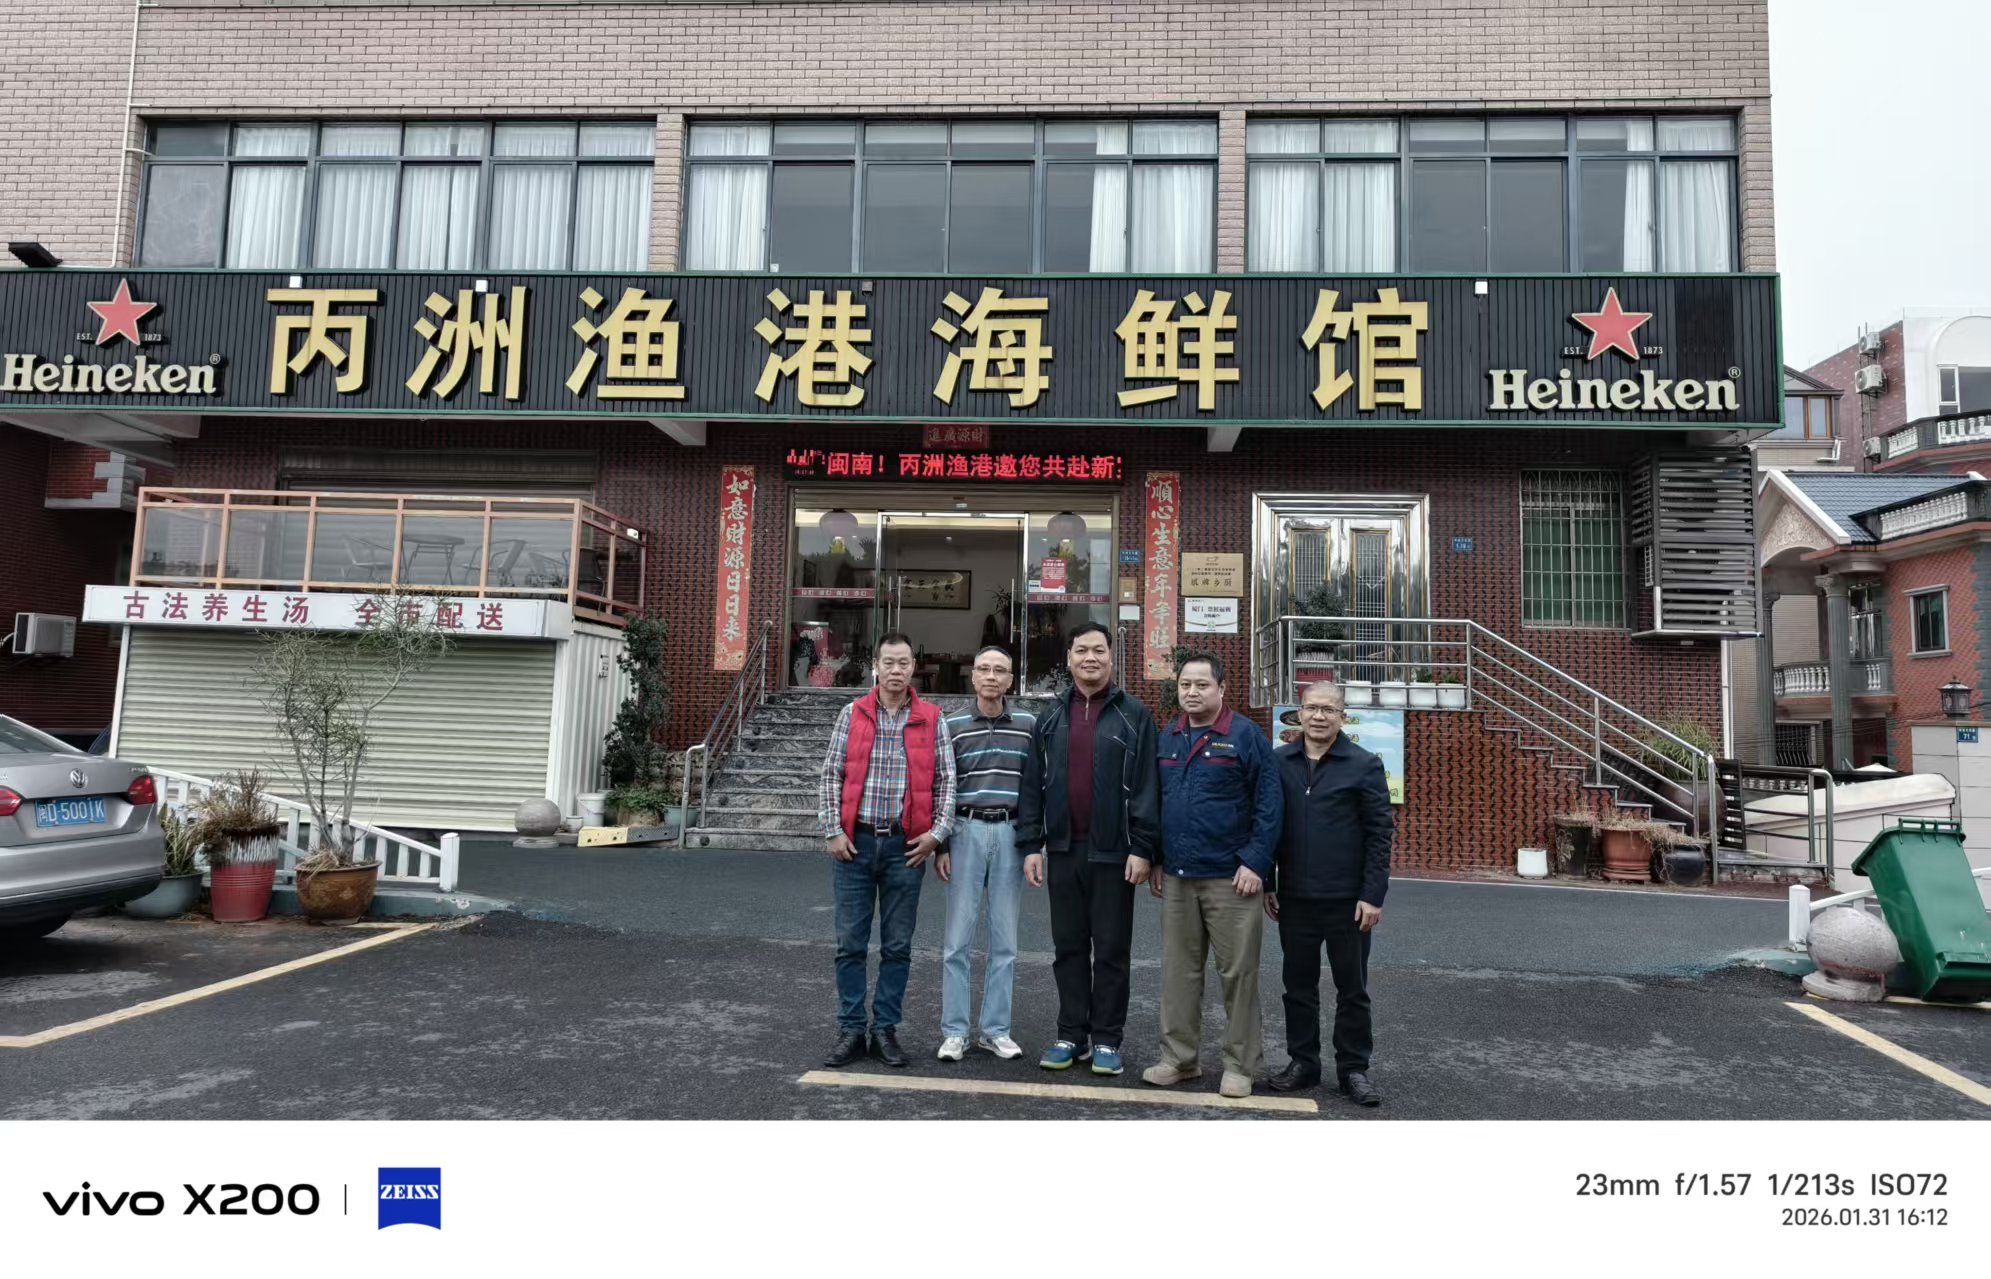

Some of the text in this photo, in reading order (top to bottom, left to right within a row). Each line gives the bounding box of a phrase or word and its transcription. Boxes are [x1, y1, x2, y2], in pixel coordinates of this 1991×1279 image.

[268, 287, 1429, 412] 丙洲渔港海鲜馆
[1563, 346, 1663, 355] EST. 1873
[827, 452, 1122, 479] 闽南！丙洲渔港邀您共赴新
[123, 591, 503, 631] 古法养生汤 全市配送
